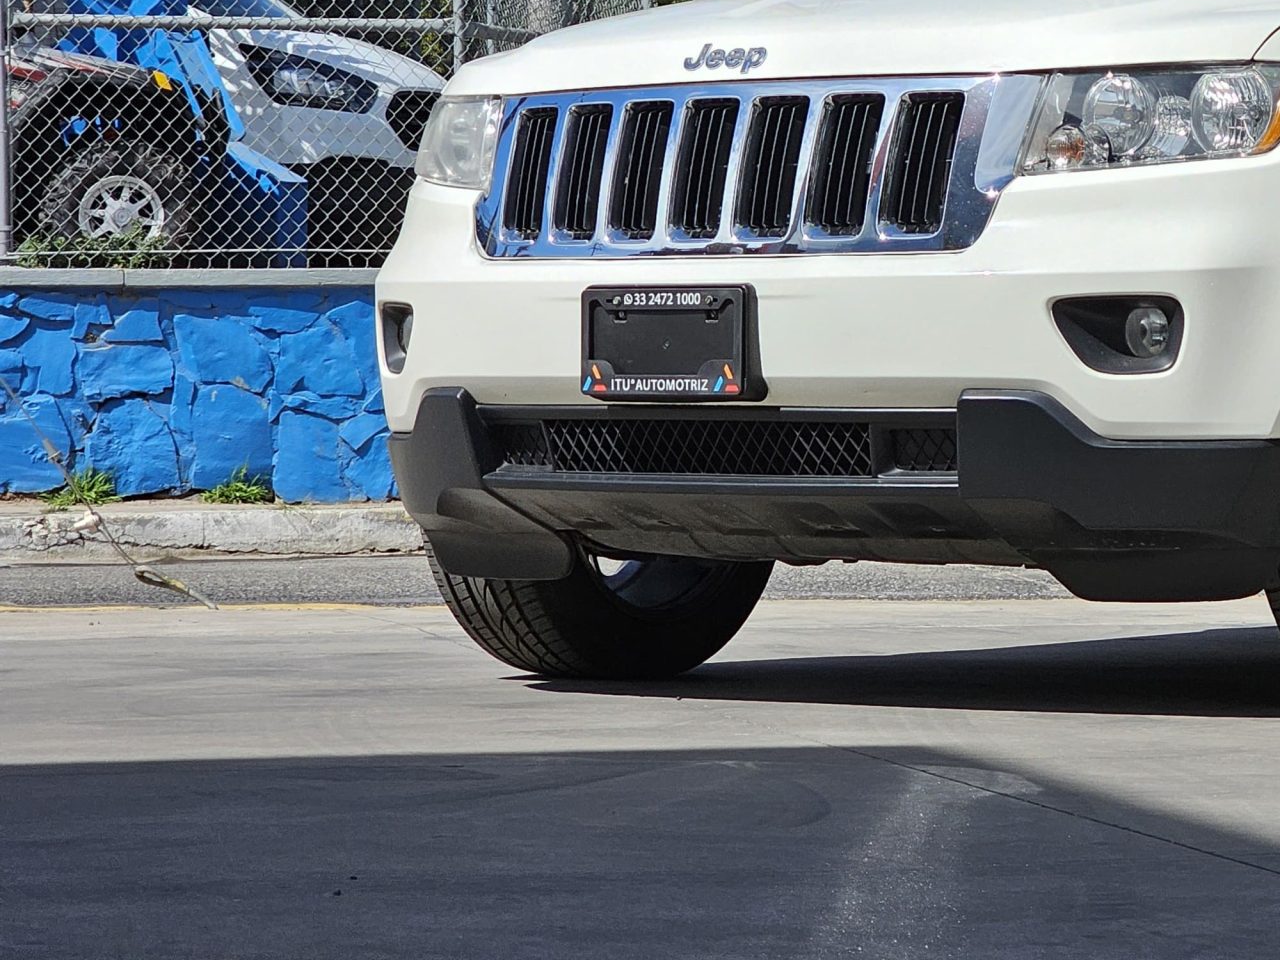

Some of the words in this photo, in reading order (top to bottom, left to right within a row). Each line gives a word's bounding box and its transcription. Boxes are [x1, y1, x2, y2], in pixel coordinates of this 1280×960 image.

[684, 43, 767, 74] Jeep
[633, 292, 646, 305] 33
[648, 292, 673, 305] 2472
[676, 292, 701, 305] 1000
